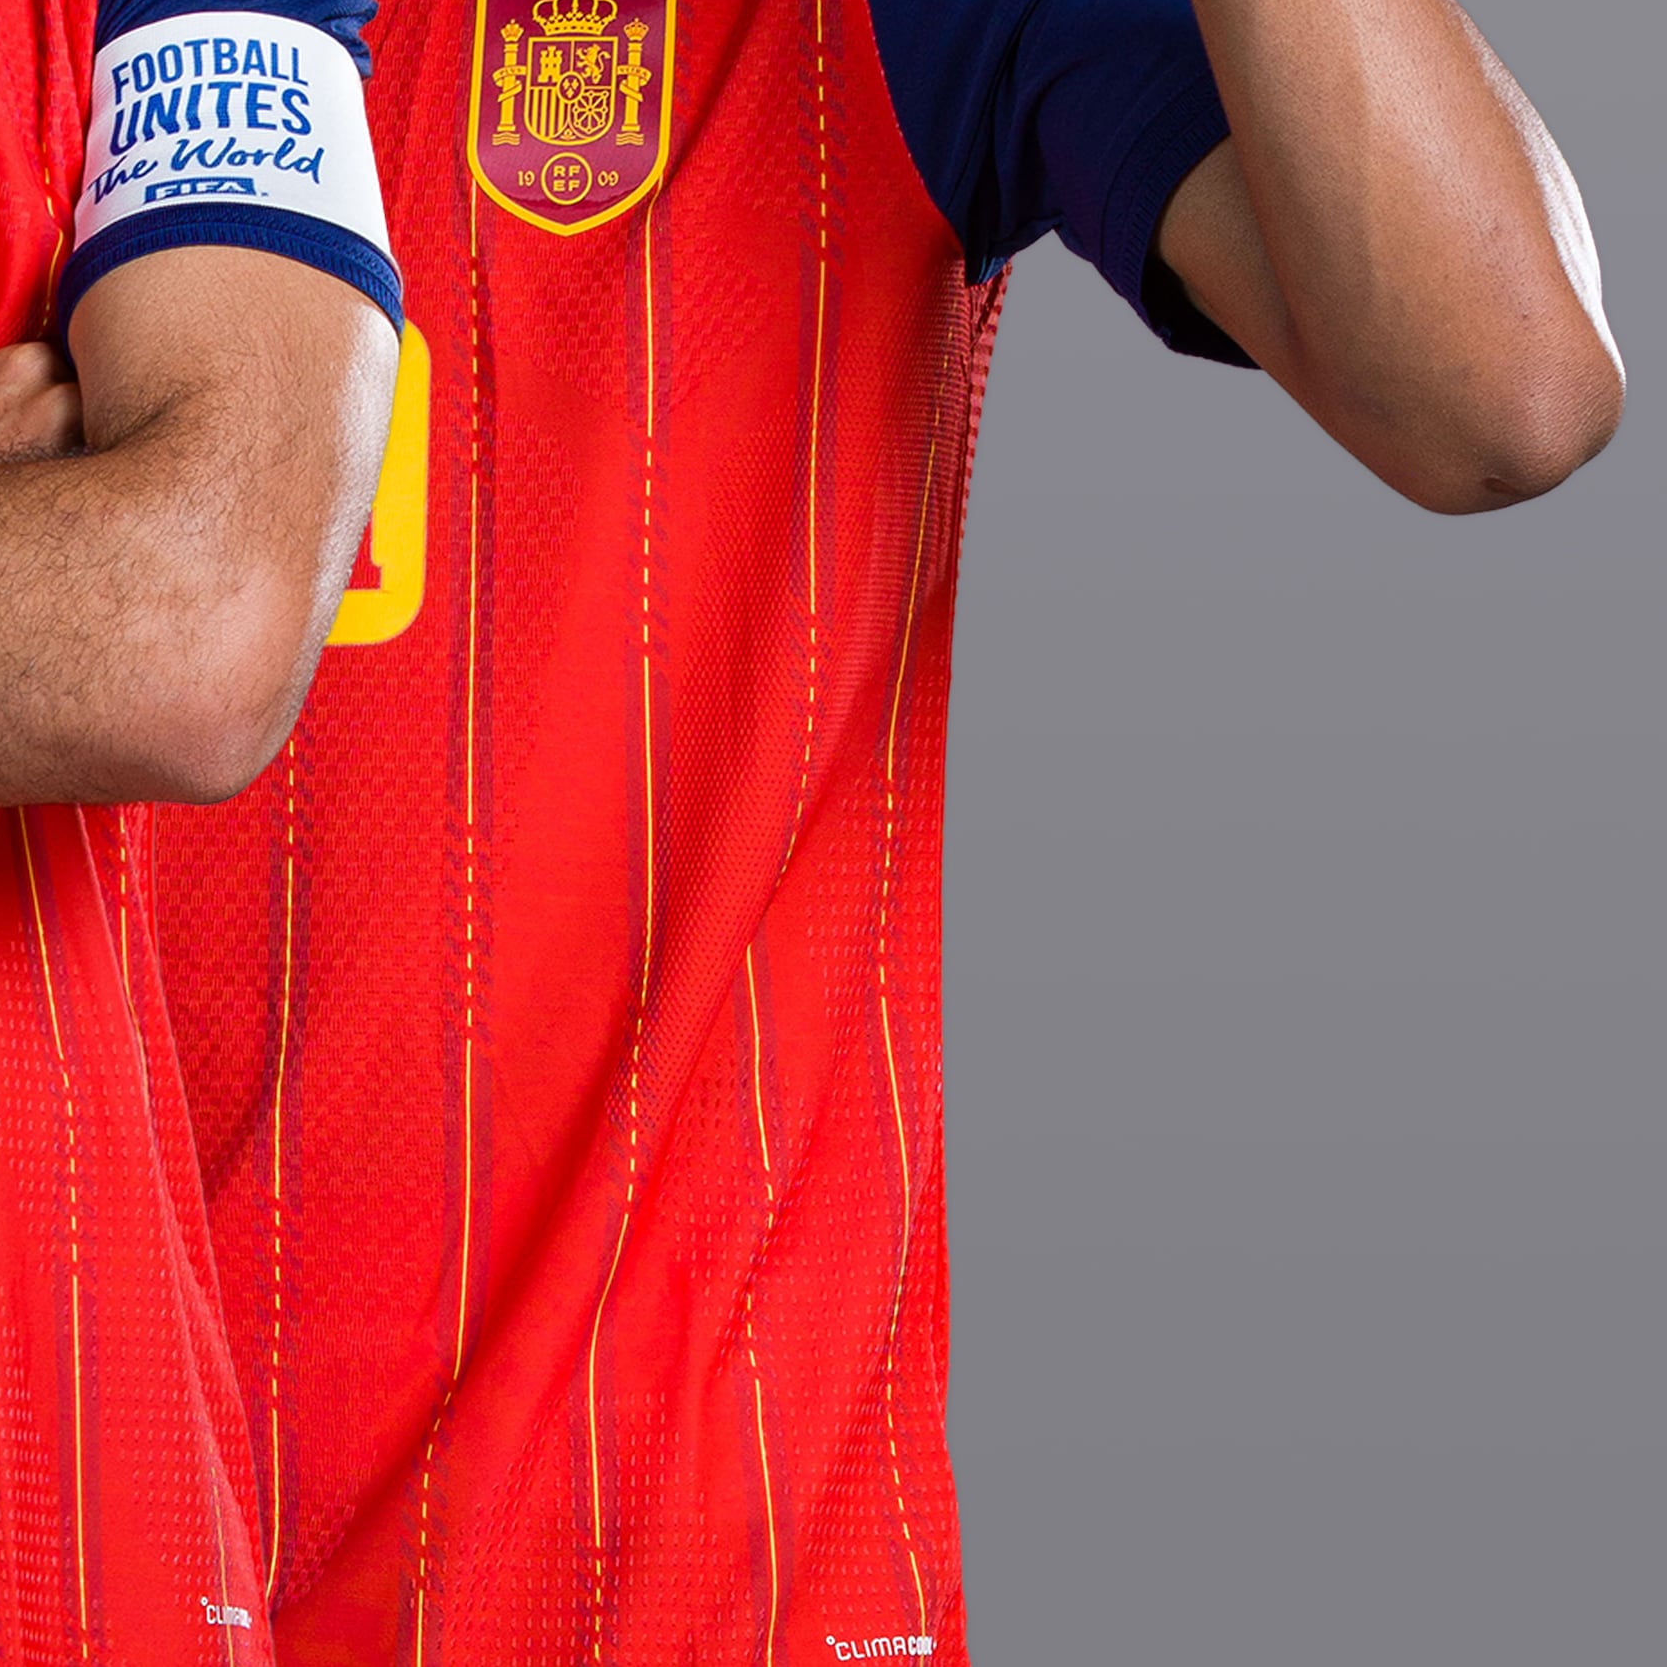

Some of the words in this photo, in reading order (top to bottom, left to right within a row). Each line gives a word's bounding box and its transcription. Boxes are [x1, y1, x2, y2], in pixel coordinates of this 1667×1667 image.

[111, 38, 309, 105] FOOTBALL
[109, 81, 312, 156] UNITES
[171, 136, 325, 184] World
[518, 170, 535, 186] 19
[597, 170, 619, 186] 09
[149, 178, 253, 202] FIFA
